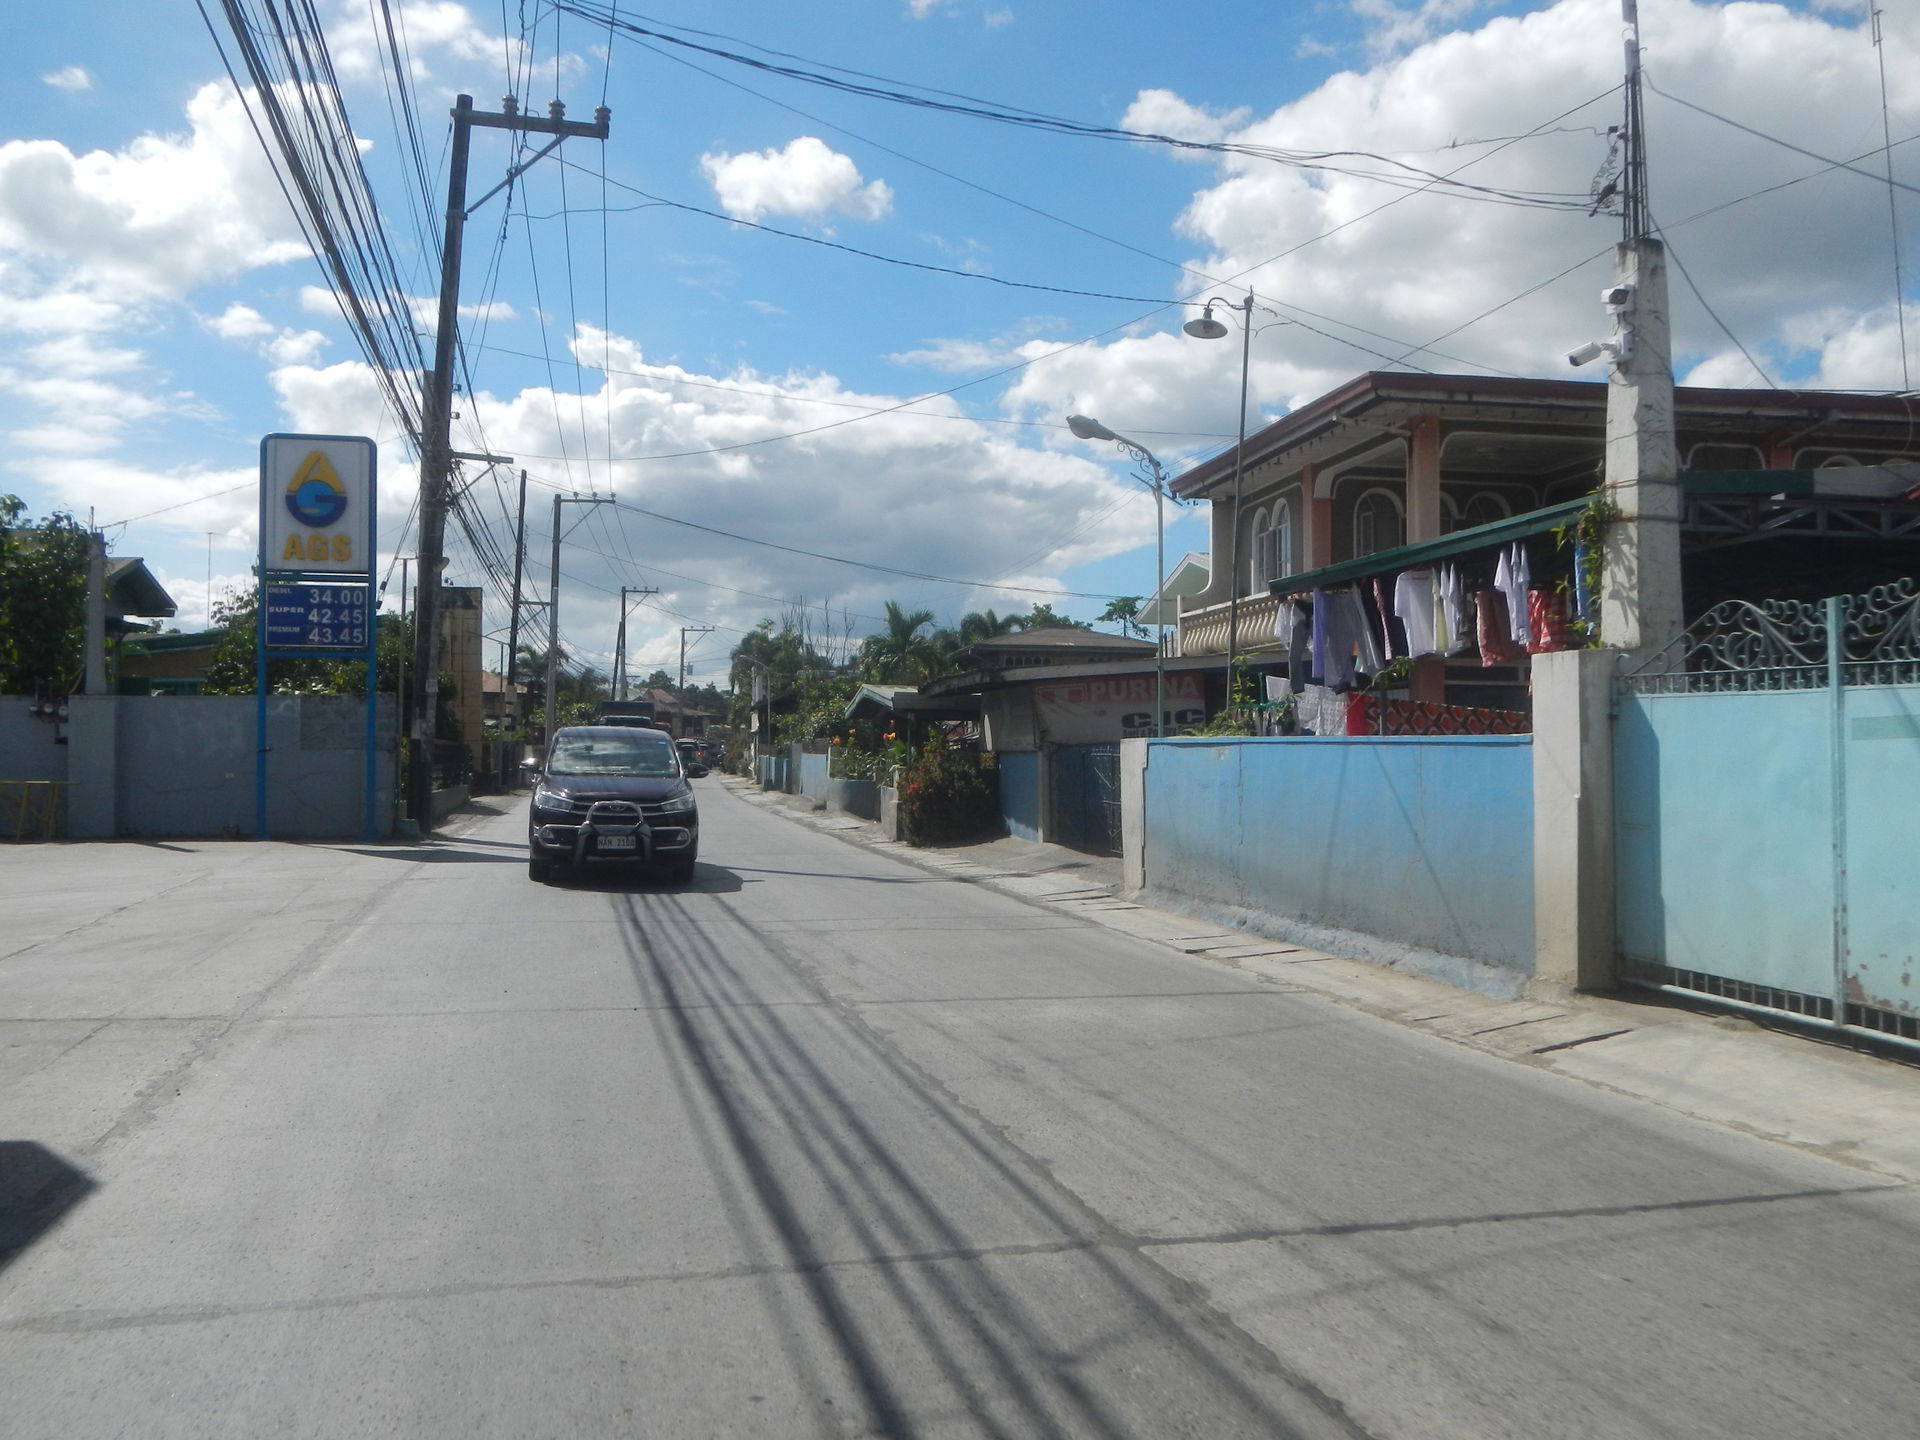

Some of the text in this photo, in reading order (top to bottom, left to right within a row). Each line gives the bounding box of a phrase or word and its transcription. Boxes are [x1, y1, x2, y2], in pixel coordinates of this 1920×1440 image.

[283, 534, 352, 562] AGS
[309, 588, 363, 605] 34.00
[308, 608, 363, 625] 42.45
[308, 627, 363, 644] 43.45
[1089, 676, 1198, 700] PURINA
